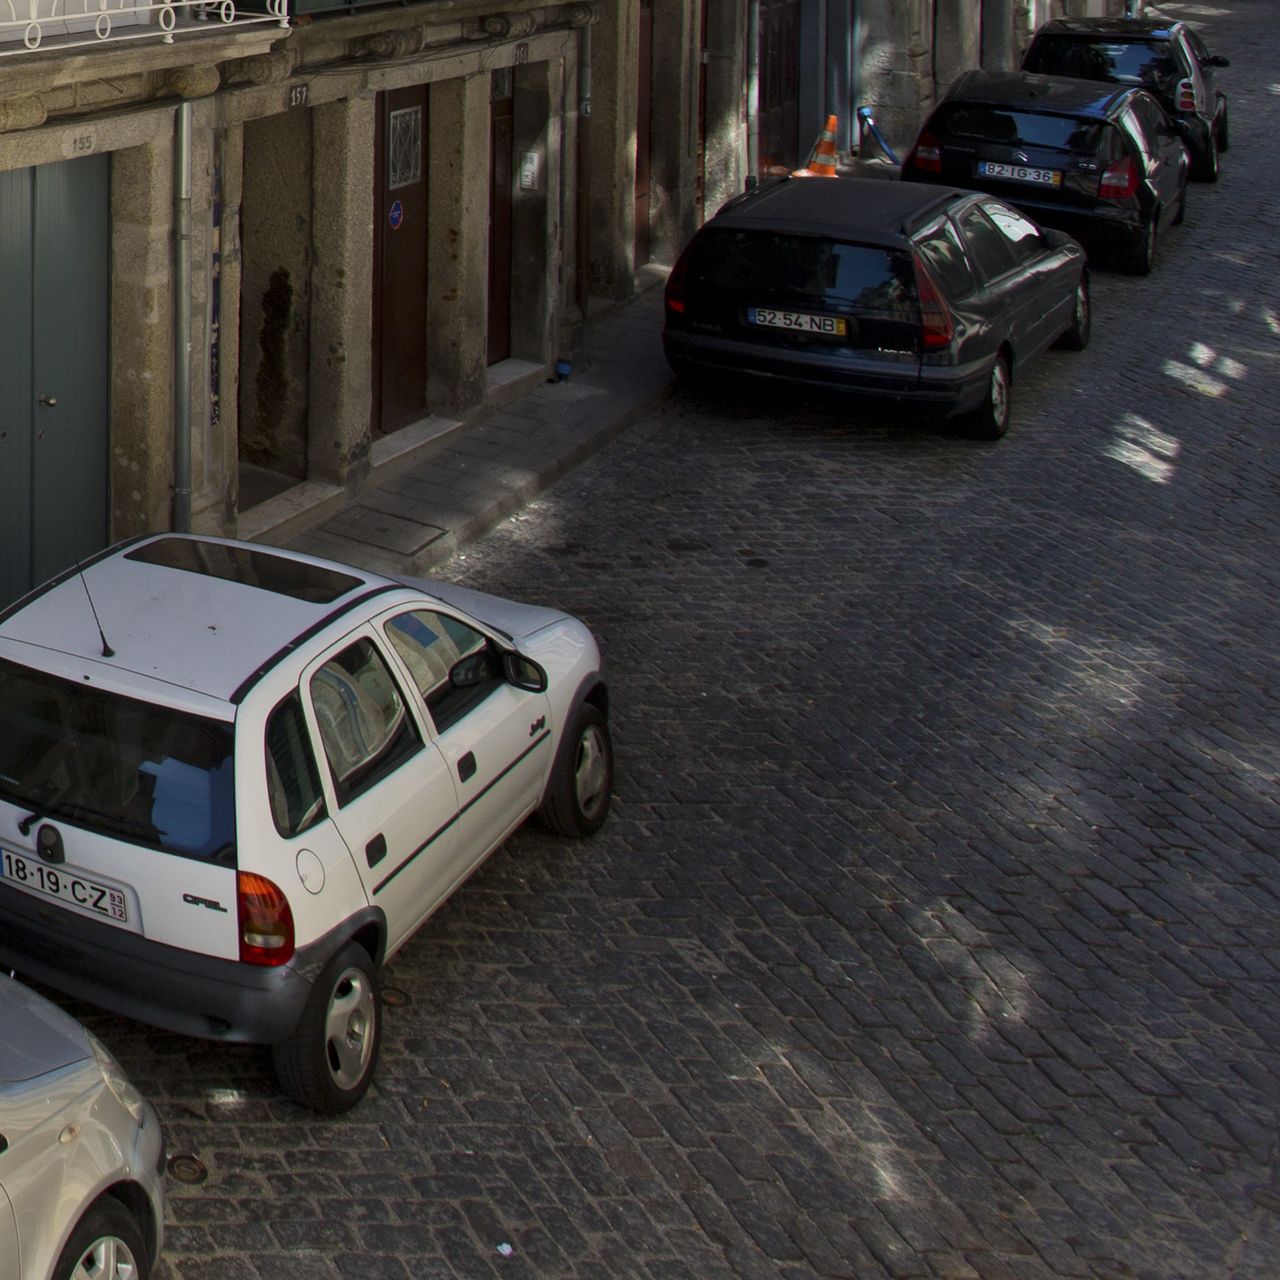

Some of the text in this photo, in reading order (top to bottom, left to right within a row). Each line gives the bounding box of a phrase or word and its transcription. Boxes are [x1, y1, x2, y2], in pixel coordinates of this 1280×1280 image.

[290, 86, 308, 107] 157
[73, 134, 92, 152] 155
[111, 906, 125, 918] 12
[182, 893, 228, 913] OPEL
